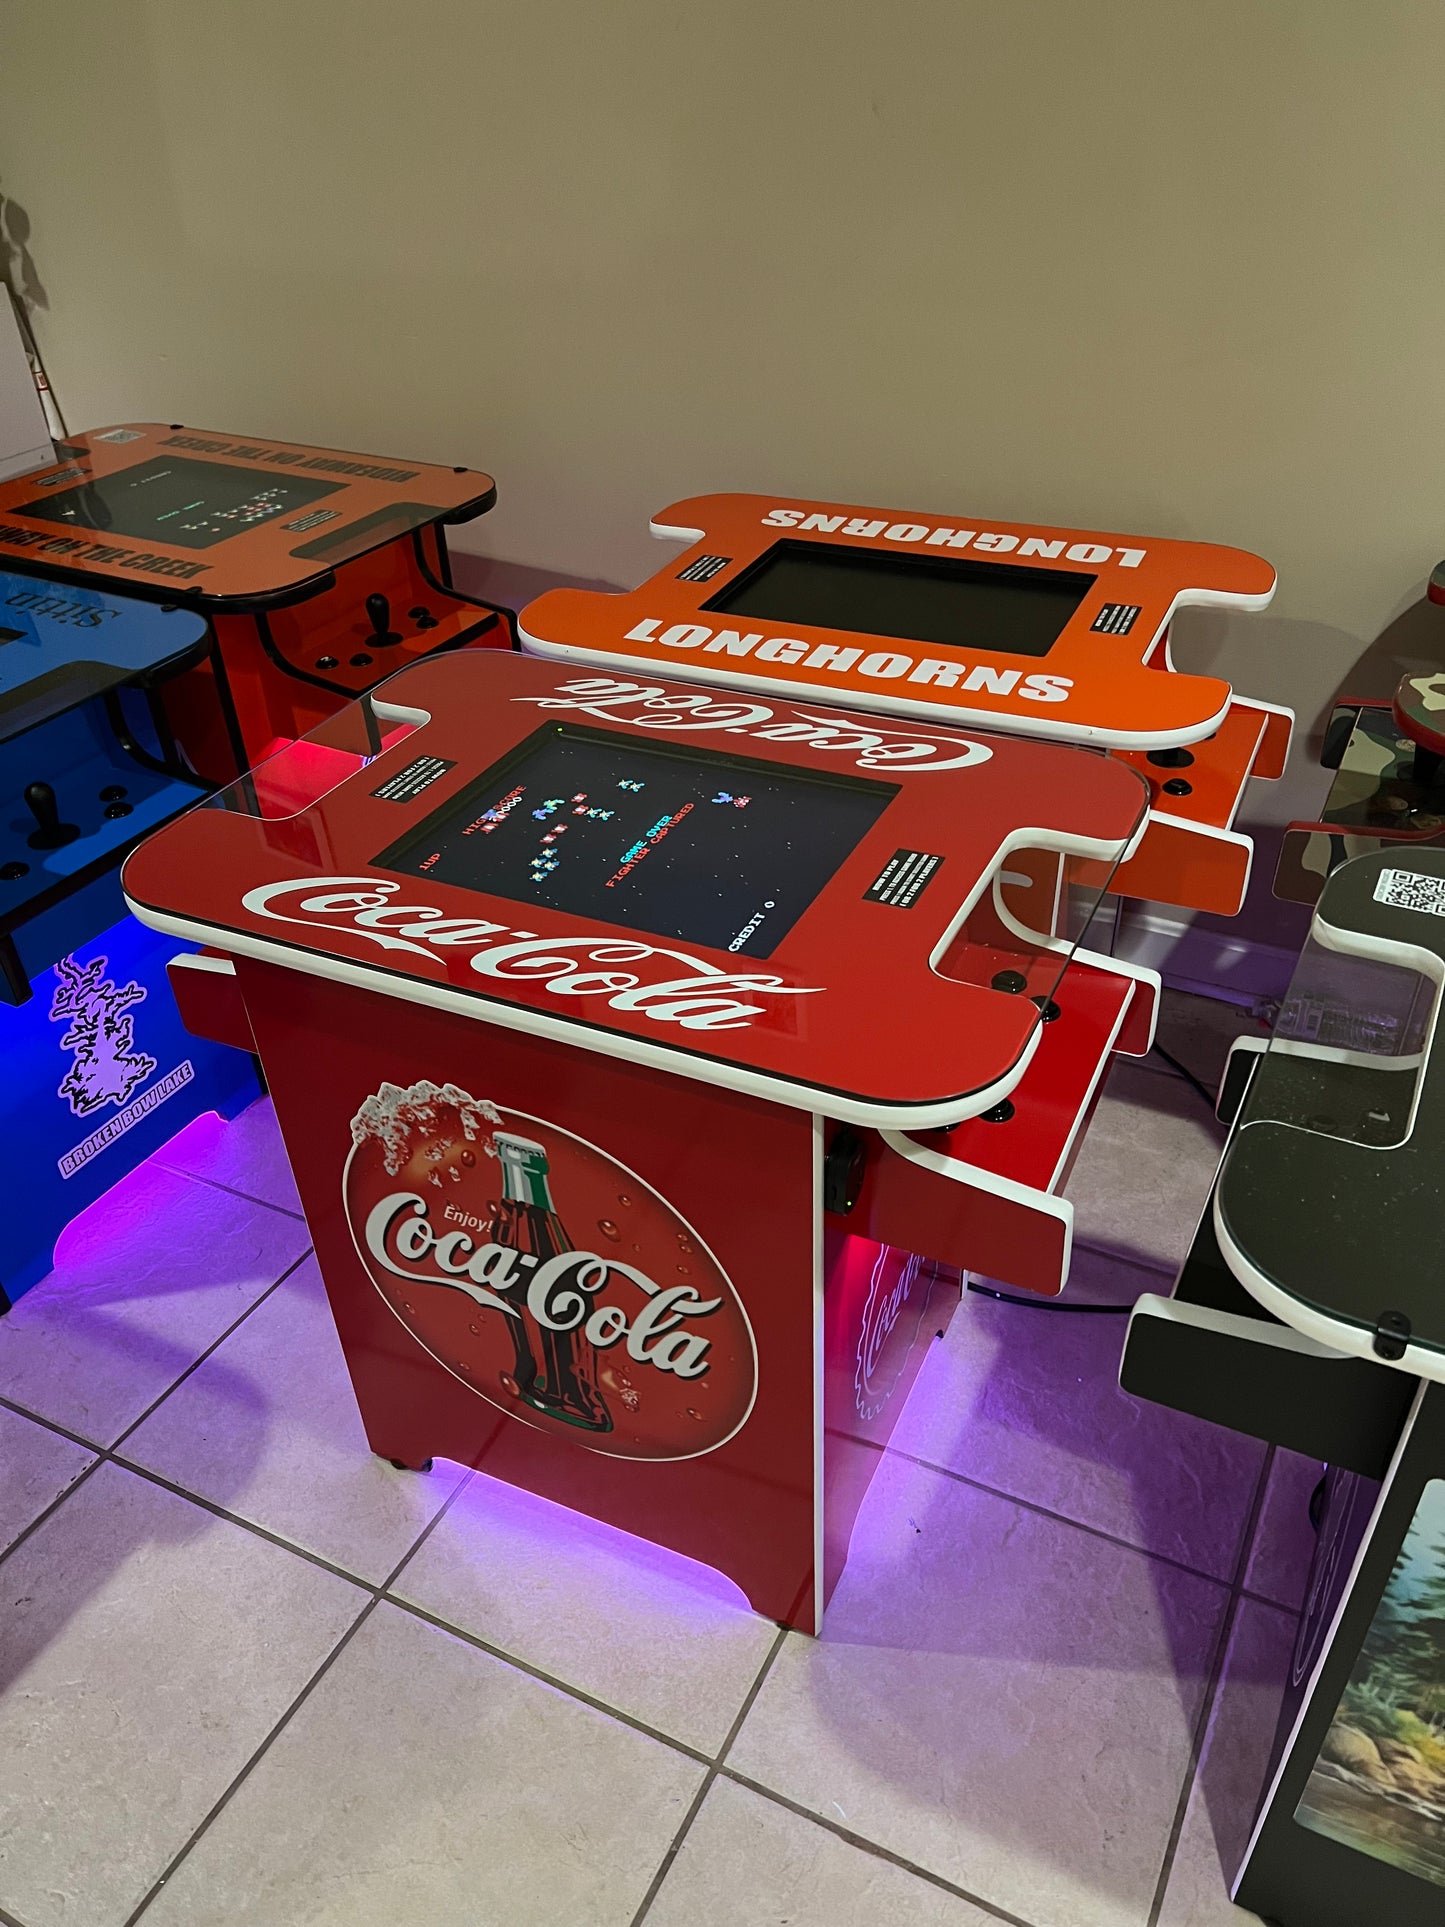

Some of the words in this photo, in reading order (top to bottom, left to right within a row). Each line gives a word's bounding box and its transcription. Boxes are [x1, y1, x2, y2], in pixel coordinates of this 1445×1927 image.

[264, 451, 306, 465] ON
[37, 537, 90, 554] ON
[72, 544, 136, 564] THE
[118, 553, 215, 579] CREEK
[762, 509, 1147, 568] LONGHORNS
[623, 618, 1075, 703] LONGHORNS
[510, 678, 994, 772] Coca-Cola
[493, 785, 527, 811] SCORE
[418, 853, 441, 871] 1UP
[605, 847, 651, 888] FIGHTER
[650, 803, 695, 844] CAPTURED
[620, 840, 648, 863] GAME
[646, 815, 673, 838] OVER
[242, 877, 827, 1030] Coca-Cola
[728, 912, 766, 952] CREDIT
[61, 1118, 122, 1175] BROKEN
[121, 1089, 158, 1128] BOW
[156, 1063, 192, 1100] LAKE
[443, 1204, 494, 1234] Enjoy!
[365, 1192, 722, 1379] Coca-Cola
